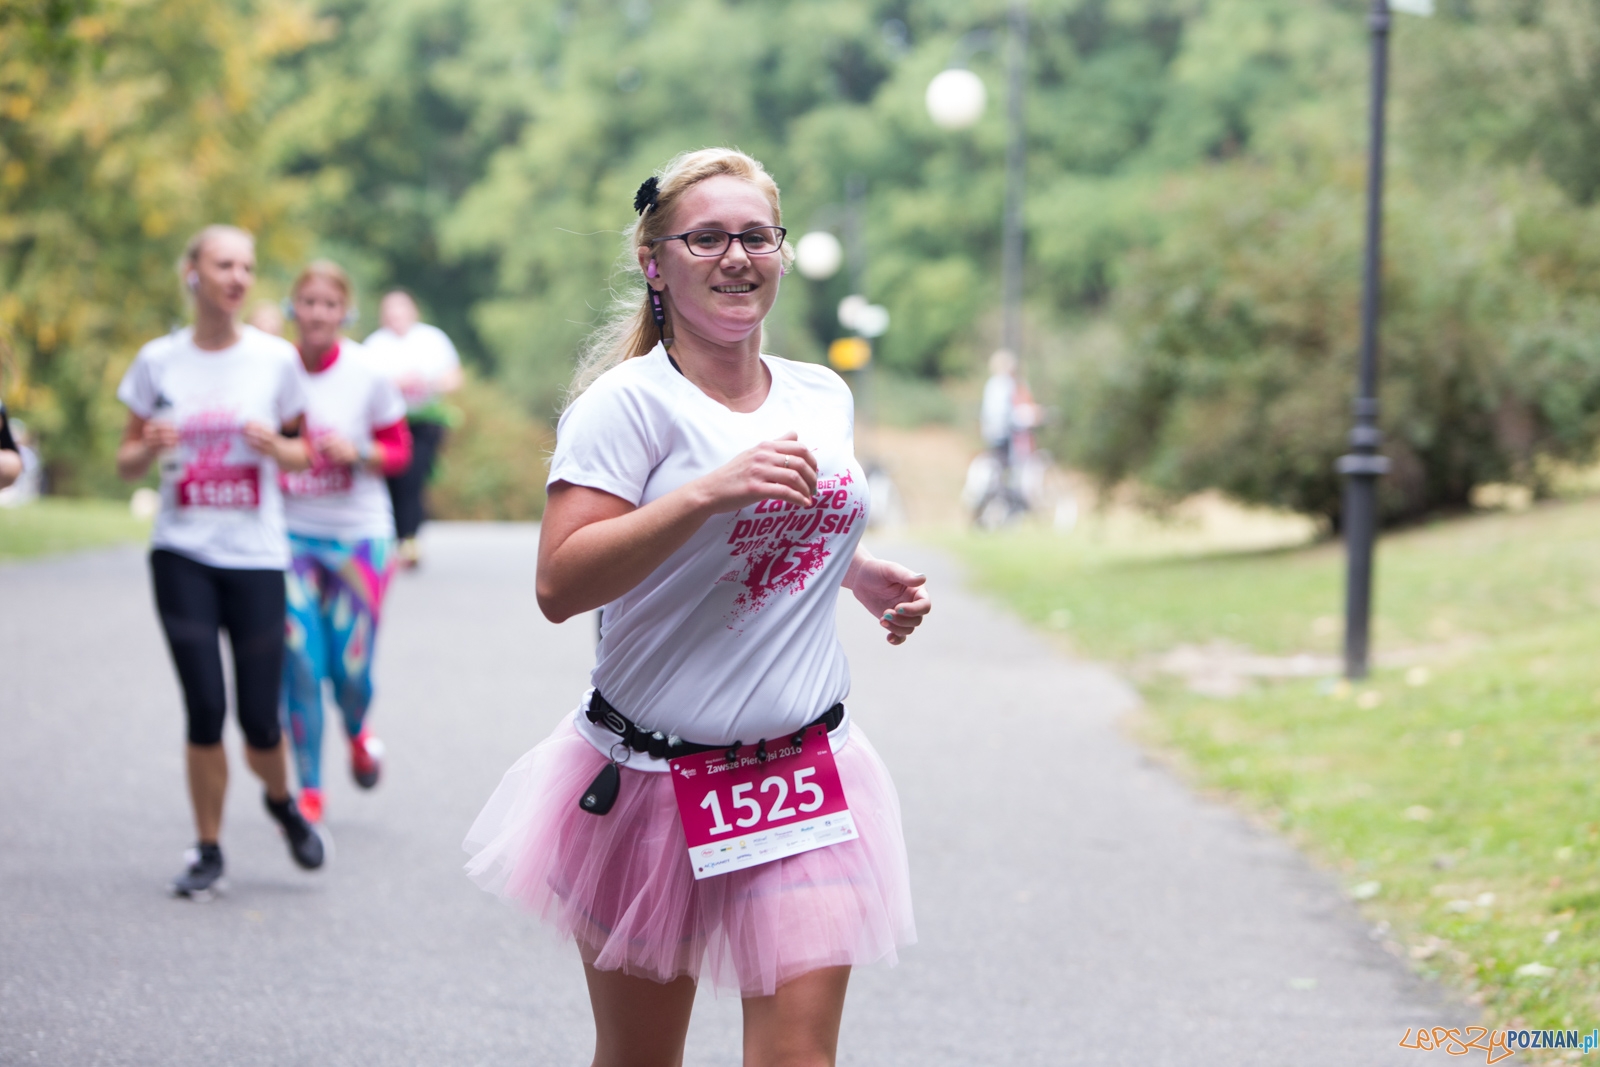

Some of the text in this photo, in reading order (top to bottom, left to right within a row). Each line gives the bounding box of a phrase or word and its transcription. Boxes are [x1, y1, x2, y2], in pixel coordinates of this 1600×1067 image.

[817, 480, 837, 489] BIET
[730, 537, 768, 556] 2016
[706, 760, 740, 775] Zawsze
[741, 751, 778, 767] Pier)si
[700, 766, 824, 836] 1525
